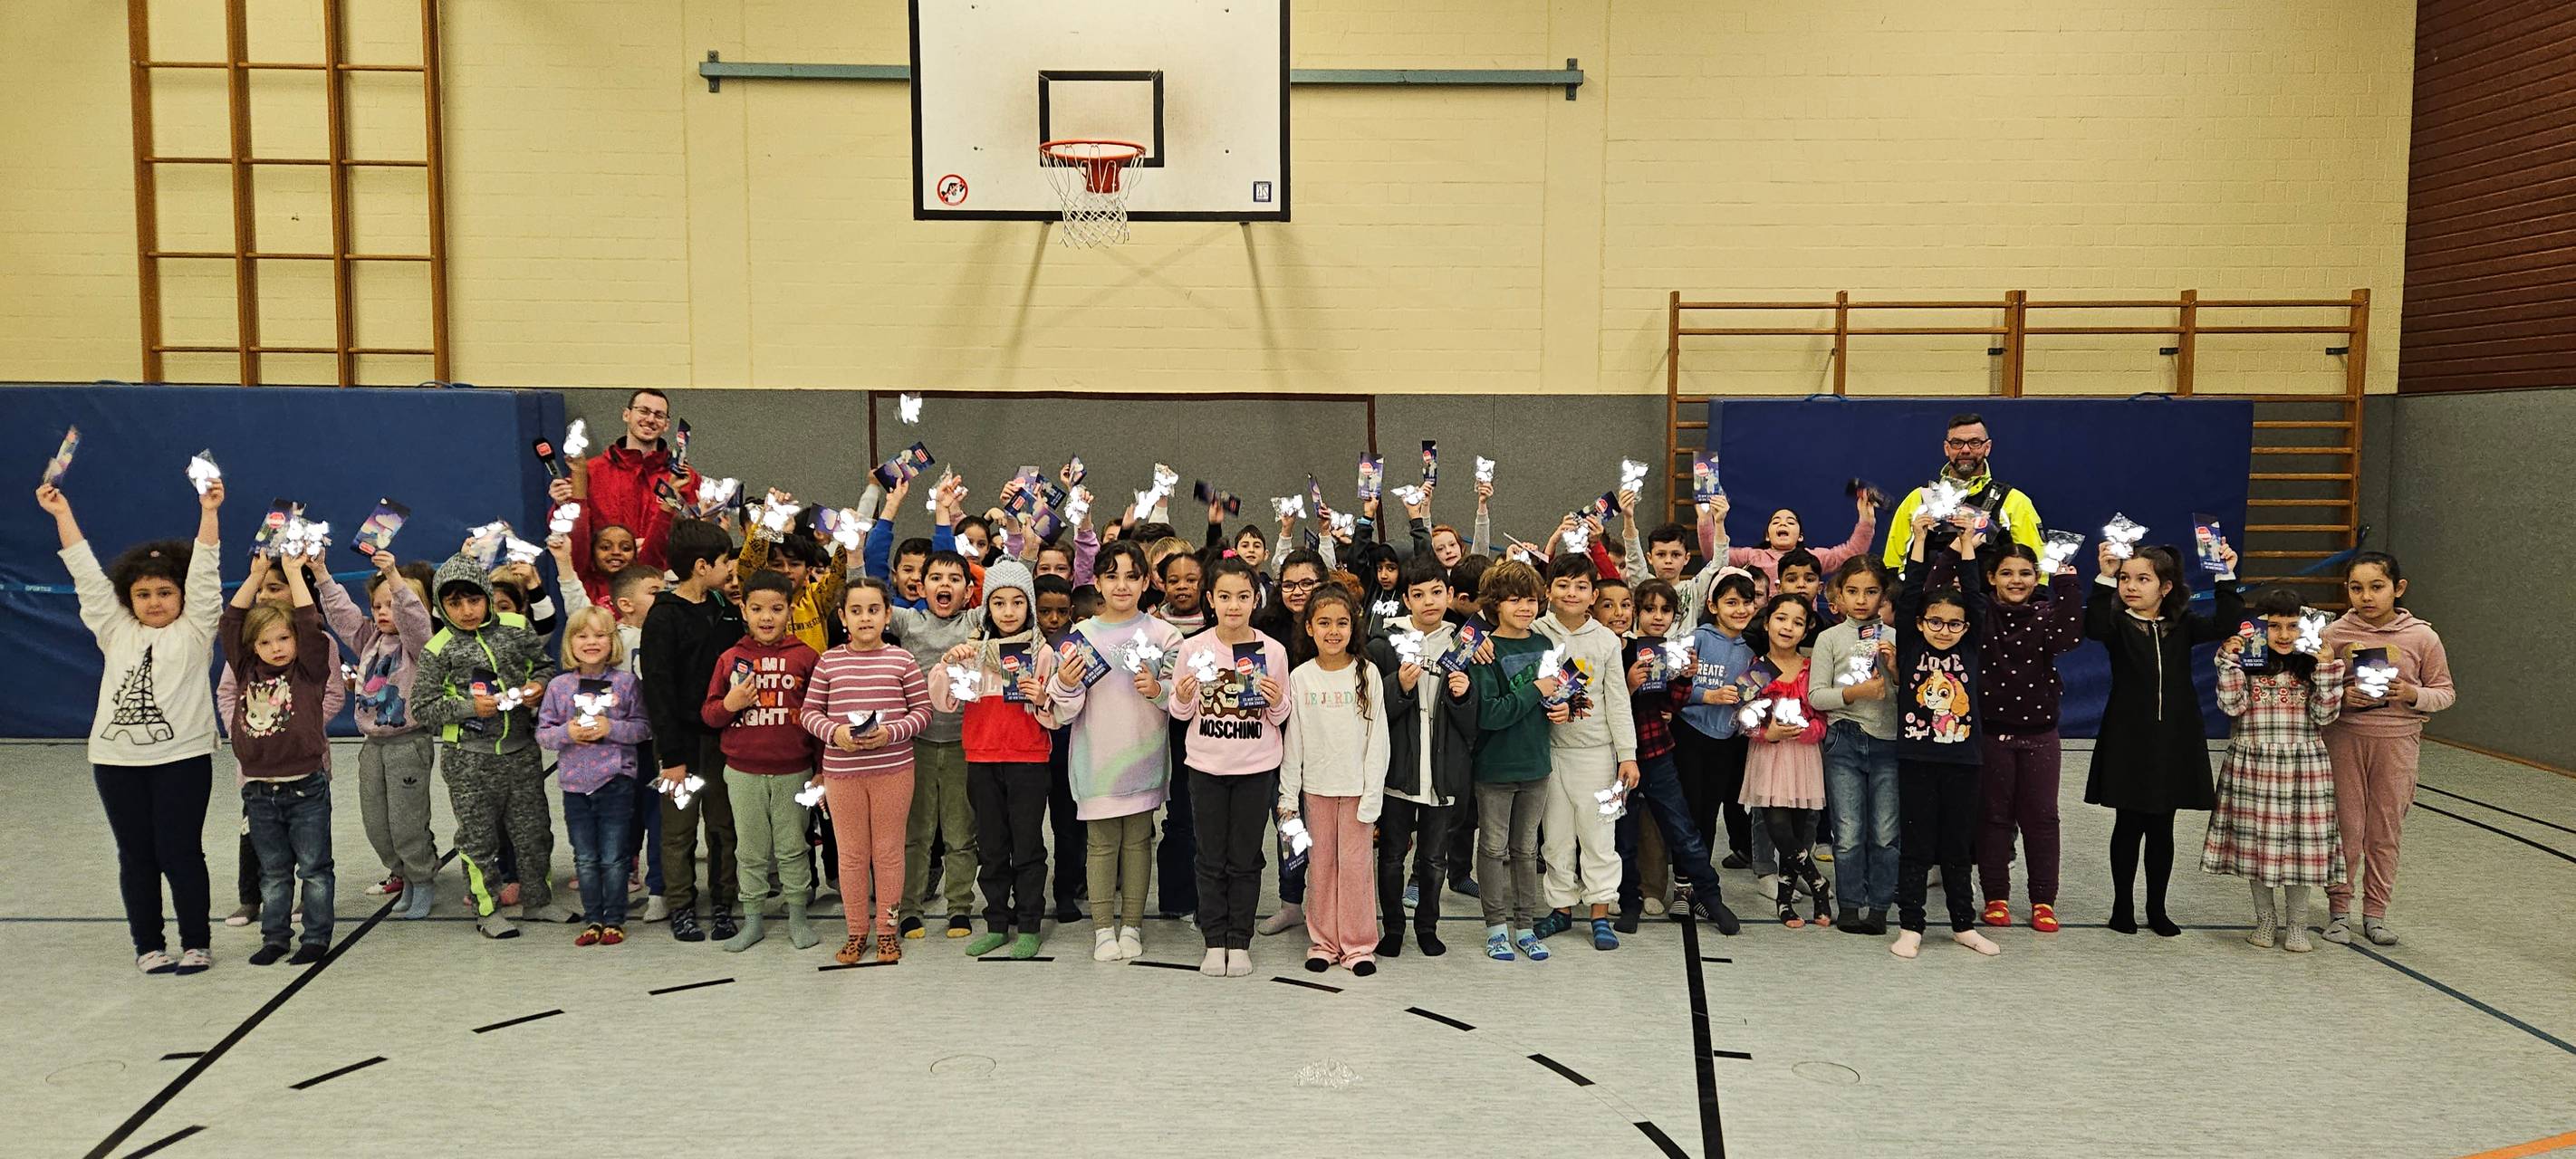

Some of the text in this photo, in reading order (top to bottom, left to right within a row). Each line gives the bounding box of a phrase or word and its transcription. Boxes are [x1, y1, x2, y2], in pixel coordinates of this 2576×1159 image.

[1697, 663, 1725, 677] REATE
[1916, 652, 1965, 671] LOVE
[1198, 718, 1263, 739] MOSCHINO
